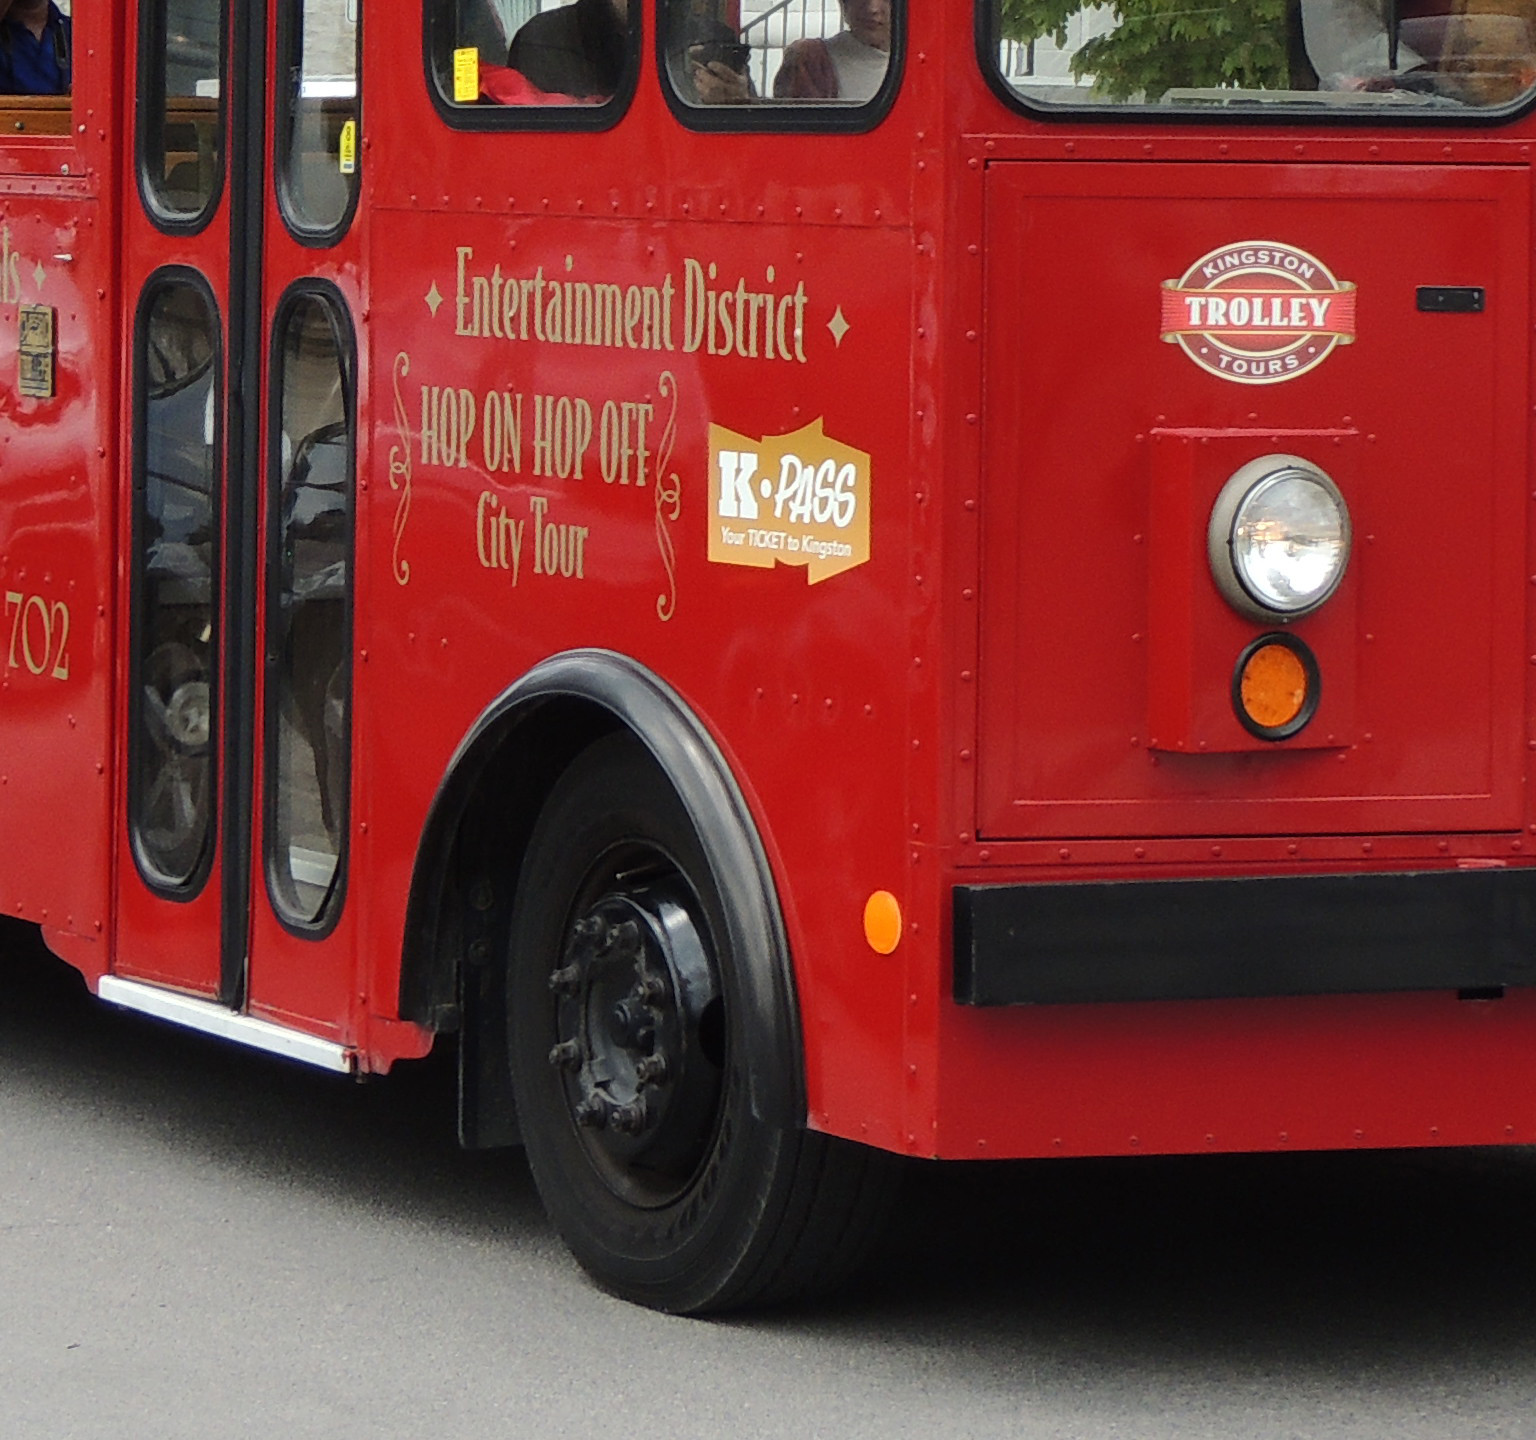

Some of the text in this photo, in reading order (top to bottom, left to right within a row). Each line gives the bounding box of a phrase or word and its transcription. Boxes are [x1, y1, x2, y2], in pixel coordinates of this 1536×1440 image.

[1202, 250, 1315, 279] KINGSTON
[455, 245, 809, 364] Entertainment District
[1185, 296, 1332, 327] TROLLEY
[1219, 354, 1300, 375] TOURS
[420, 383, 654, 488] HOP ON HOP OFF
[475, 490, 590, 588] City Tour
[720, 526, 853, 560] Your TICKET to Kingston
[4, 591, 70, 682] 702
